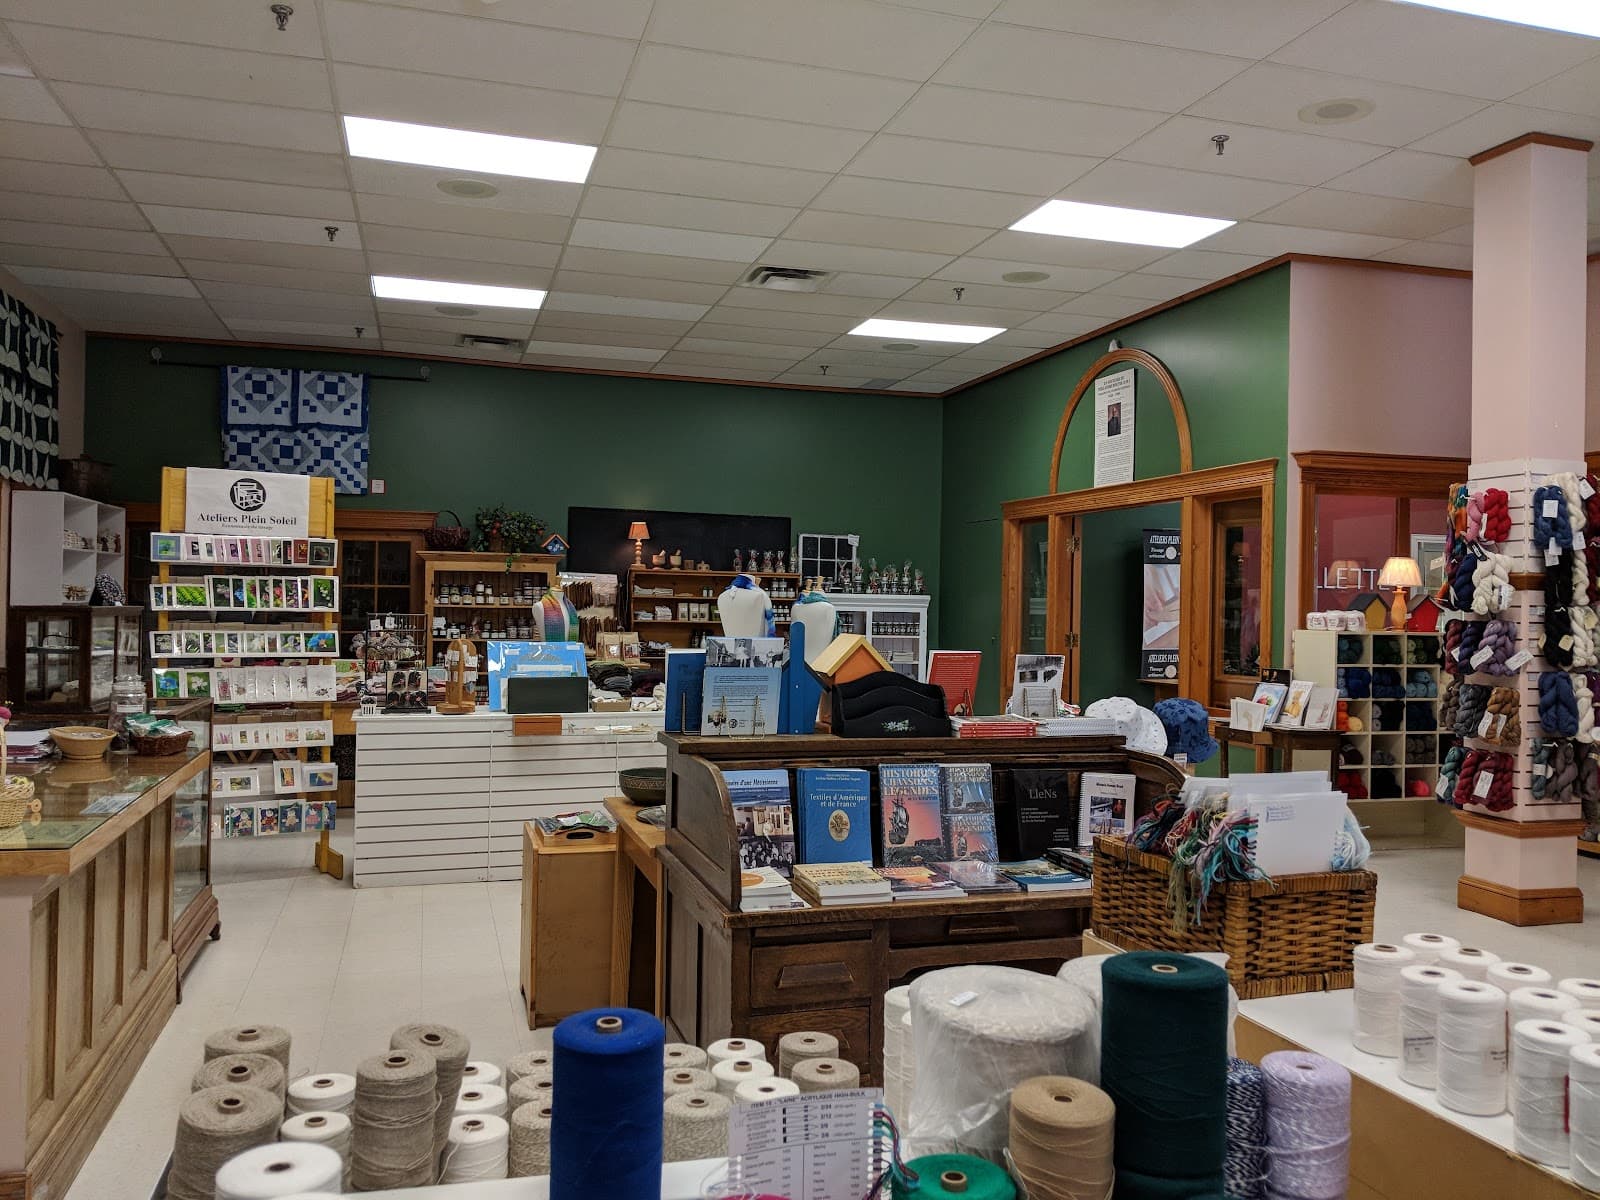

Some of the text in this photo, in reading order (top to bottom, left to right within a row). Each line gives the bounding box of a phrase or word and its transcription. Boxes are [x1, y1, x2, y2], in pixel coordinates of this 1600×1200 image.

[198, 513, 297, 526] Ateliers Plein Soleil
[810, 793, 832, 801] Textiles
[836, 800, 857, 808] France
[800, 1093, 833, 1101] ACRYLIQUE
